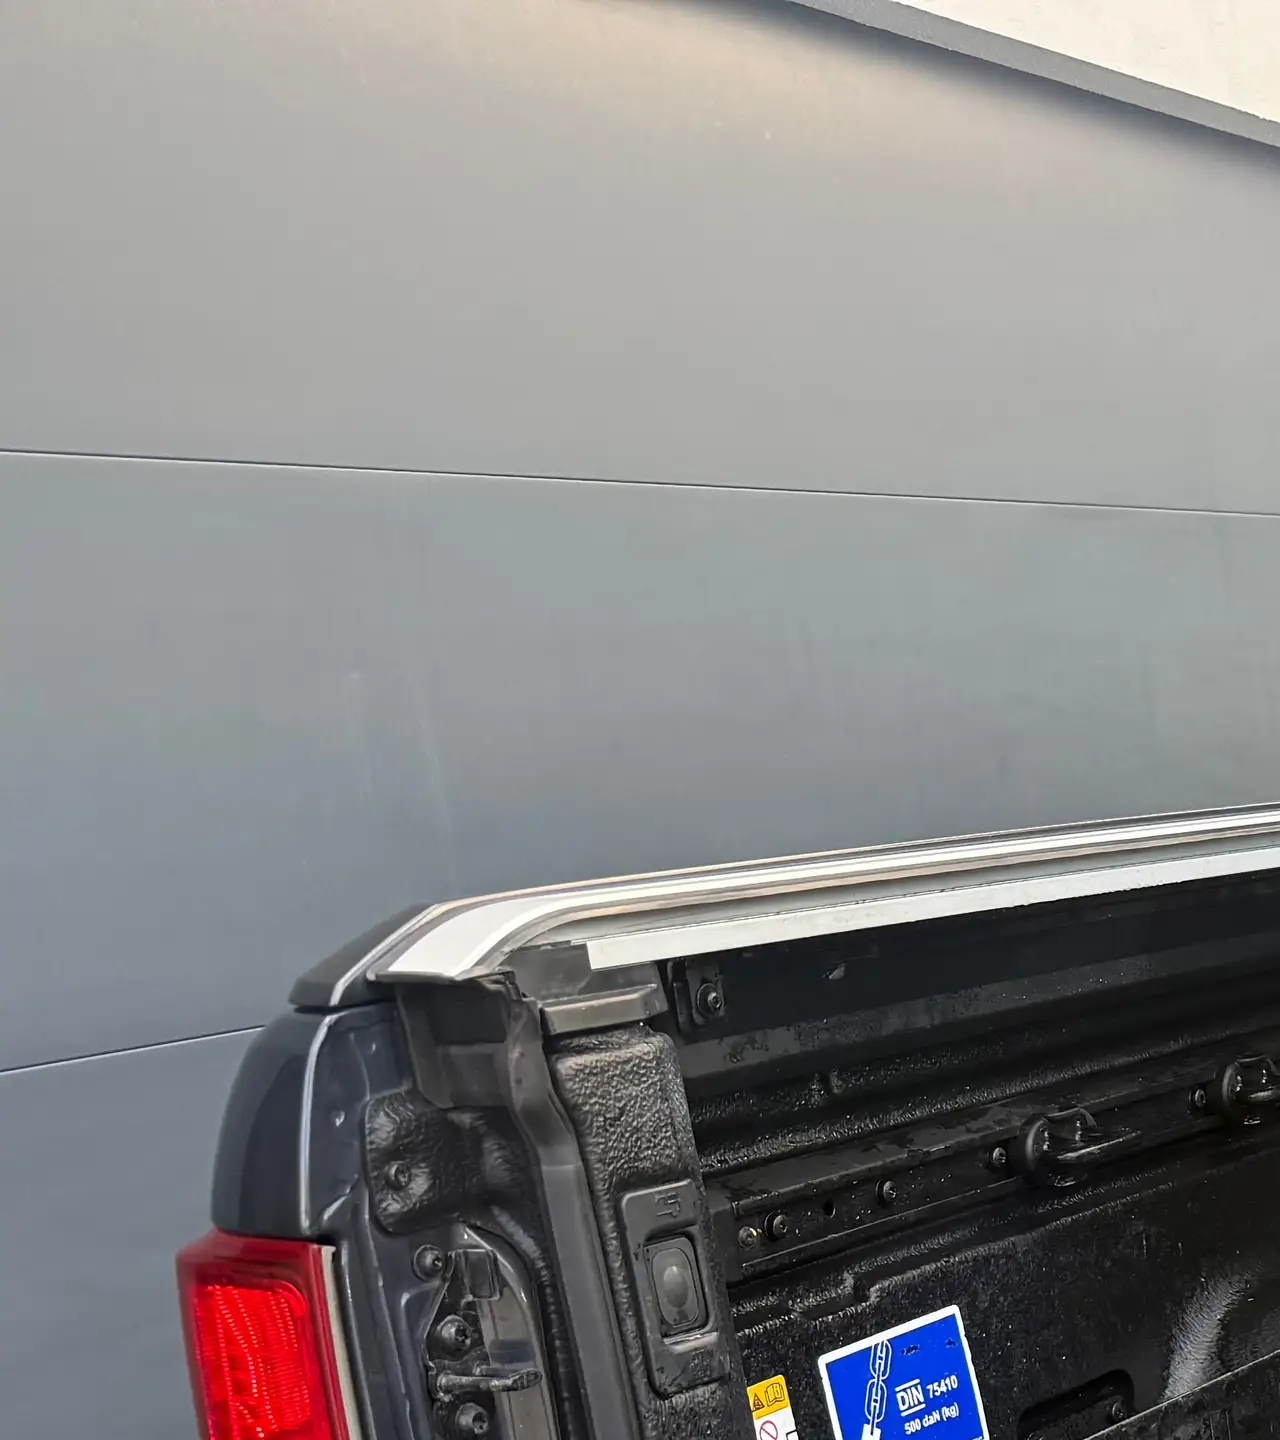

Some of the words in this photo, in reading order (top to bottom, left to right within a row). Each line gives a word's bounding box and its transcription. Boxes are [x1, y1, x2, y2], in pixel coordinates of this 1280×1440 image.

[895, 1384, 925, 1412] DIN
[926, 1375, 958, 1399] 75410
[904, 1419, 922, 1435] 500
[923, 1410, 940, 1428] daN
[941, 1402, 959, 1422] (kg)
